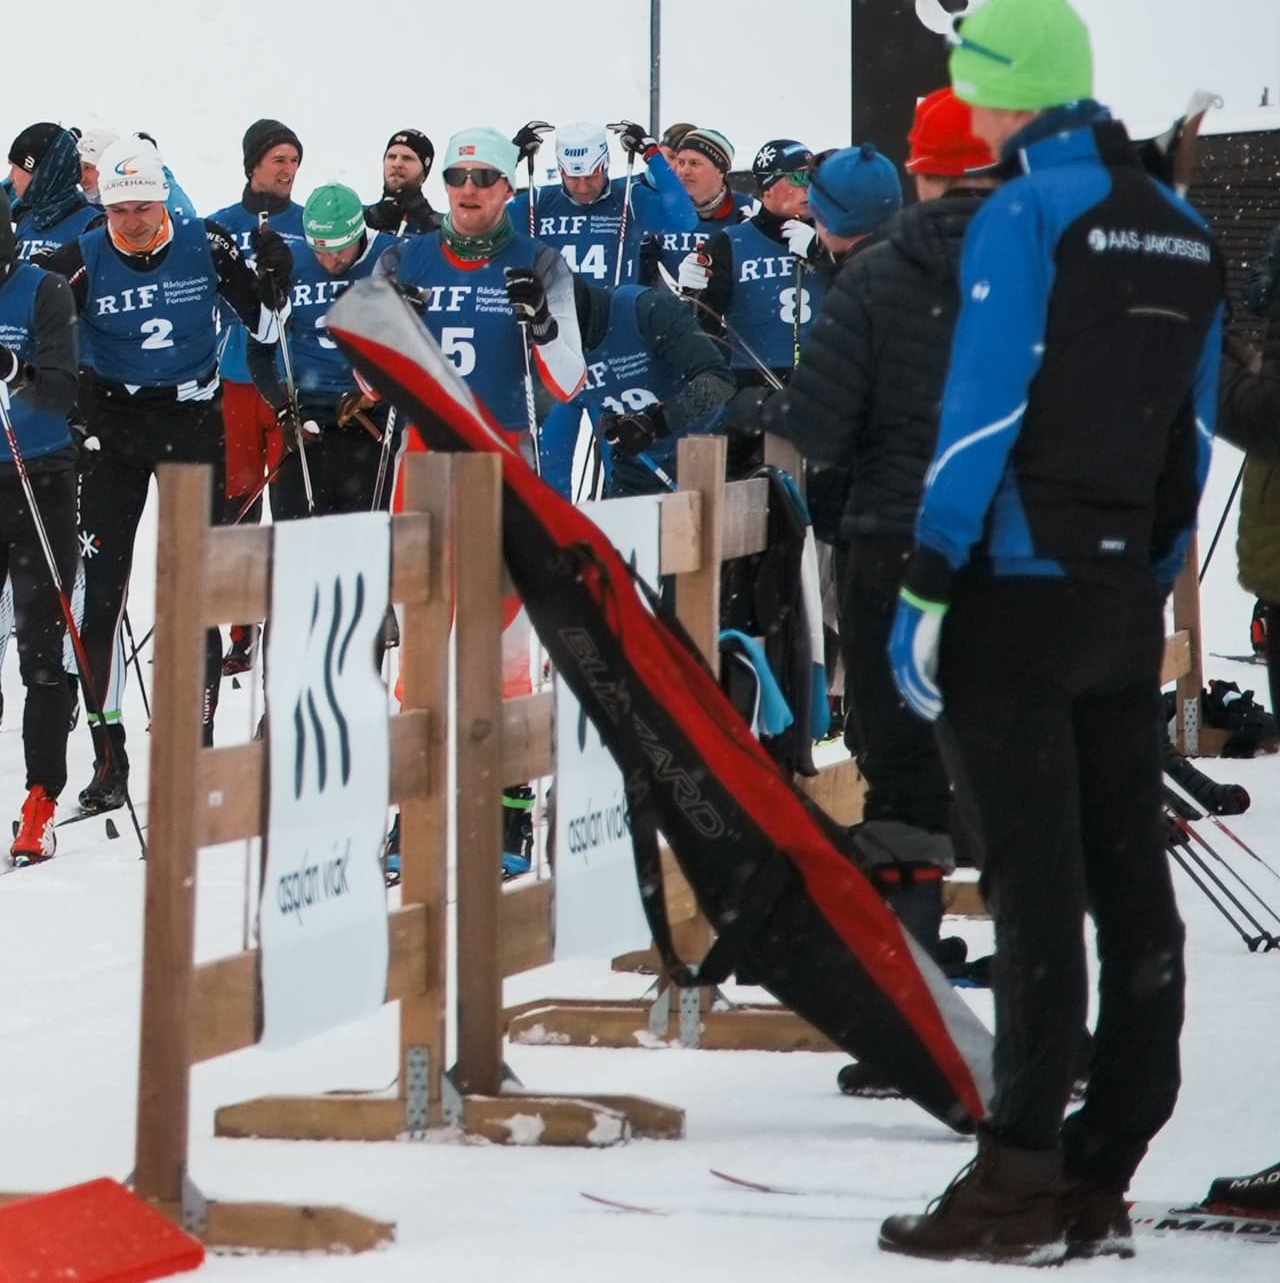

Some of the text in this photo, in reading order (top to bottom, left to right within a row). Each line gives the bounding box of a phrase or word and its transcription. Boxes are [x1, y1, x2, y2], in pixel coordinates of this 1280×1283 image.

[206, 231, 230, 250] WECO
[540, 216, 588, 236] RIF
[17, 239, 44, 260] IF
[1108, 229, 1212, 263] AAS-JAKOBSEN
[739, 255, 796, 283] RIF
[96, 284, 159, 316] RIF
[165, 293, 202, 306] Forening
[427, 286, 472, 312] IF
[475, 304, 513, 316] Forening
[779, 287, 812, 324] 8
[140, 318, 175, 351] 2
[442, 327, 476, 378] 5
[568, 797, 603, 865] asplan
[277, 837, 352, 926] asplan viak
